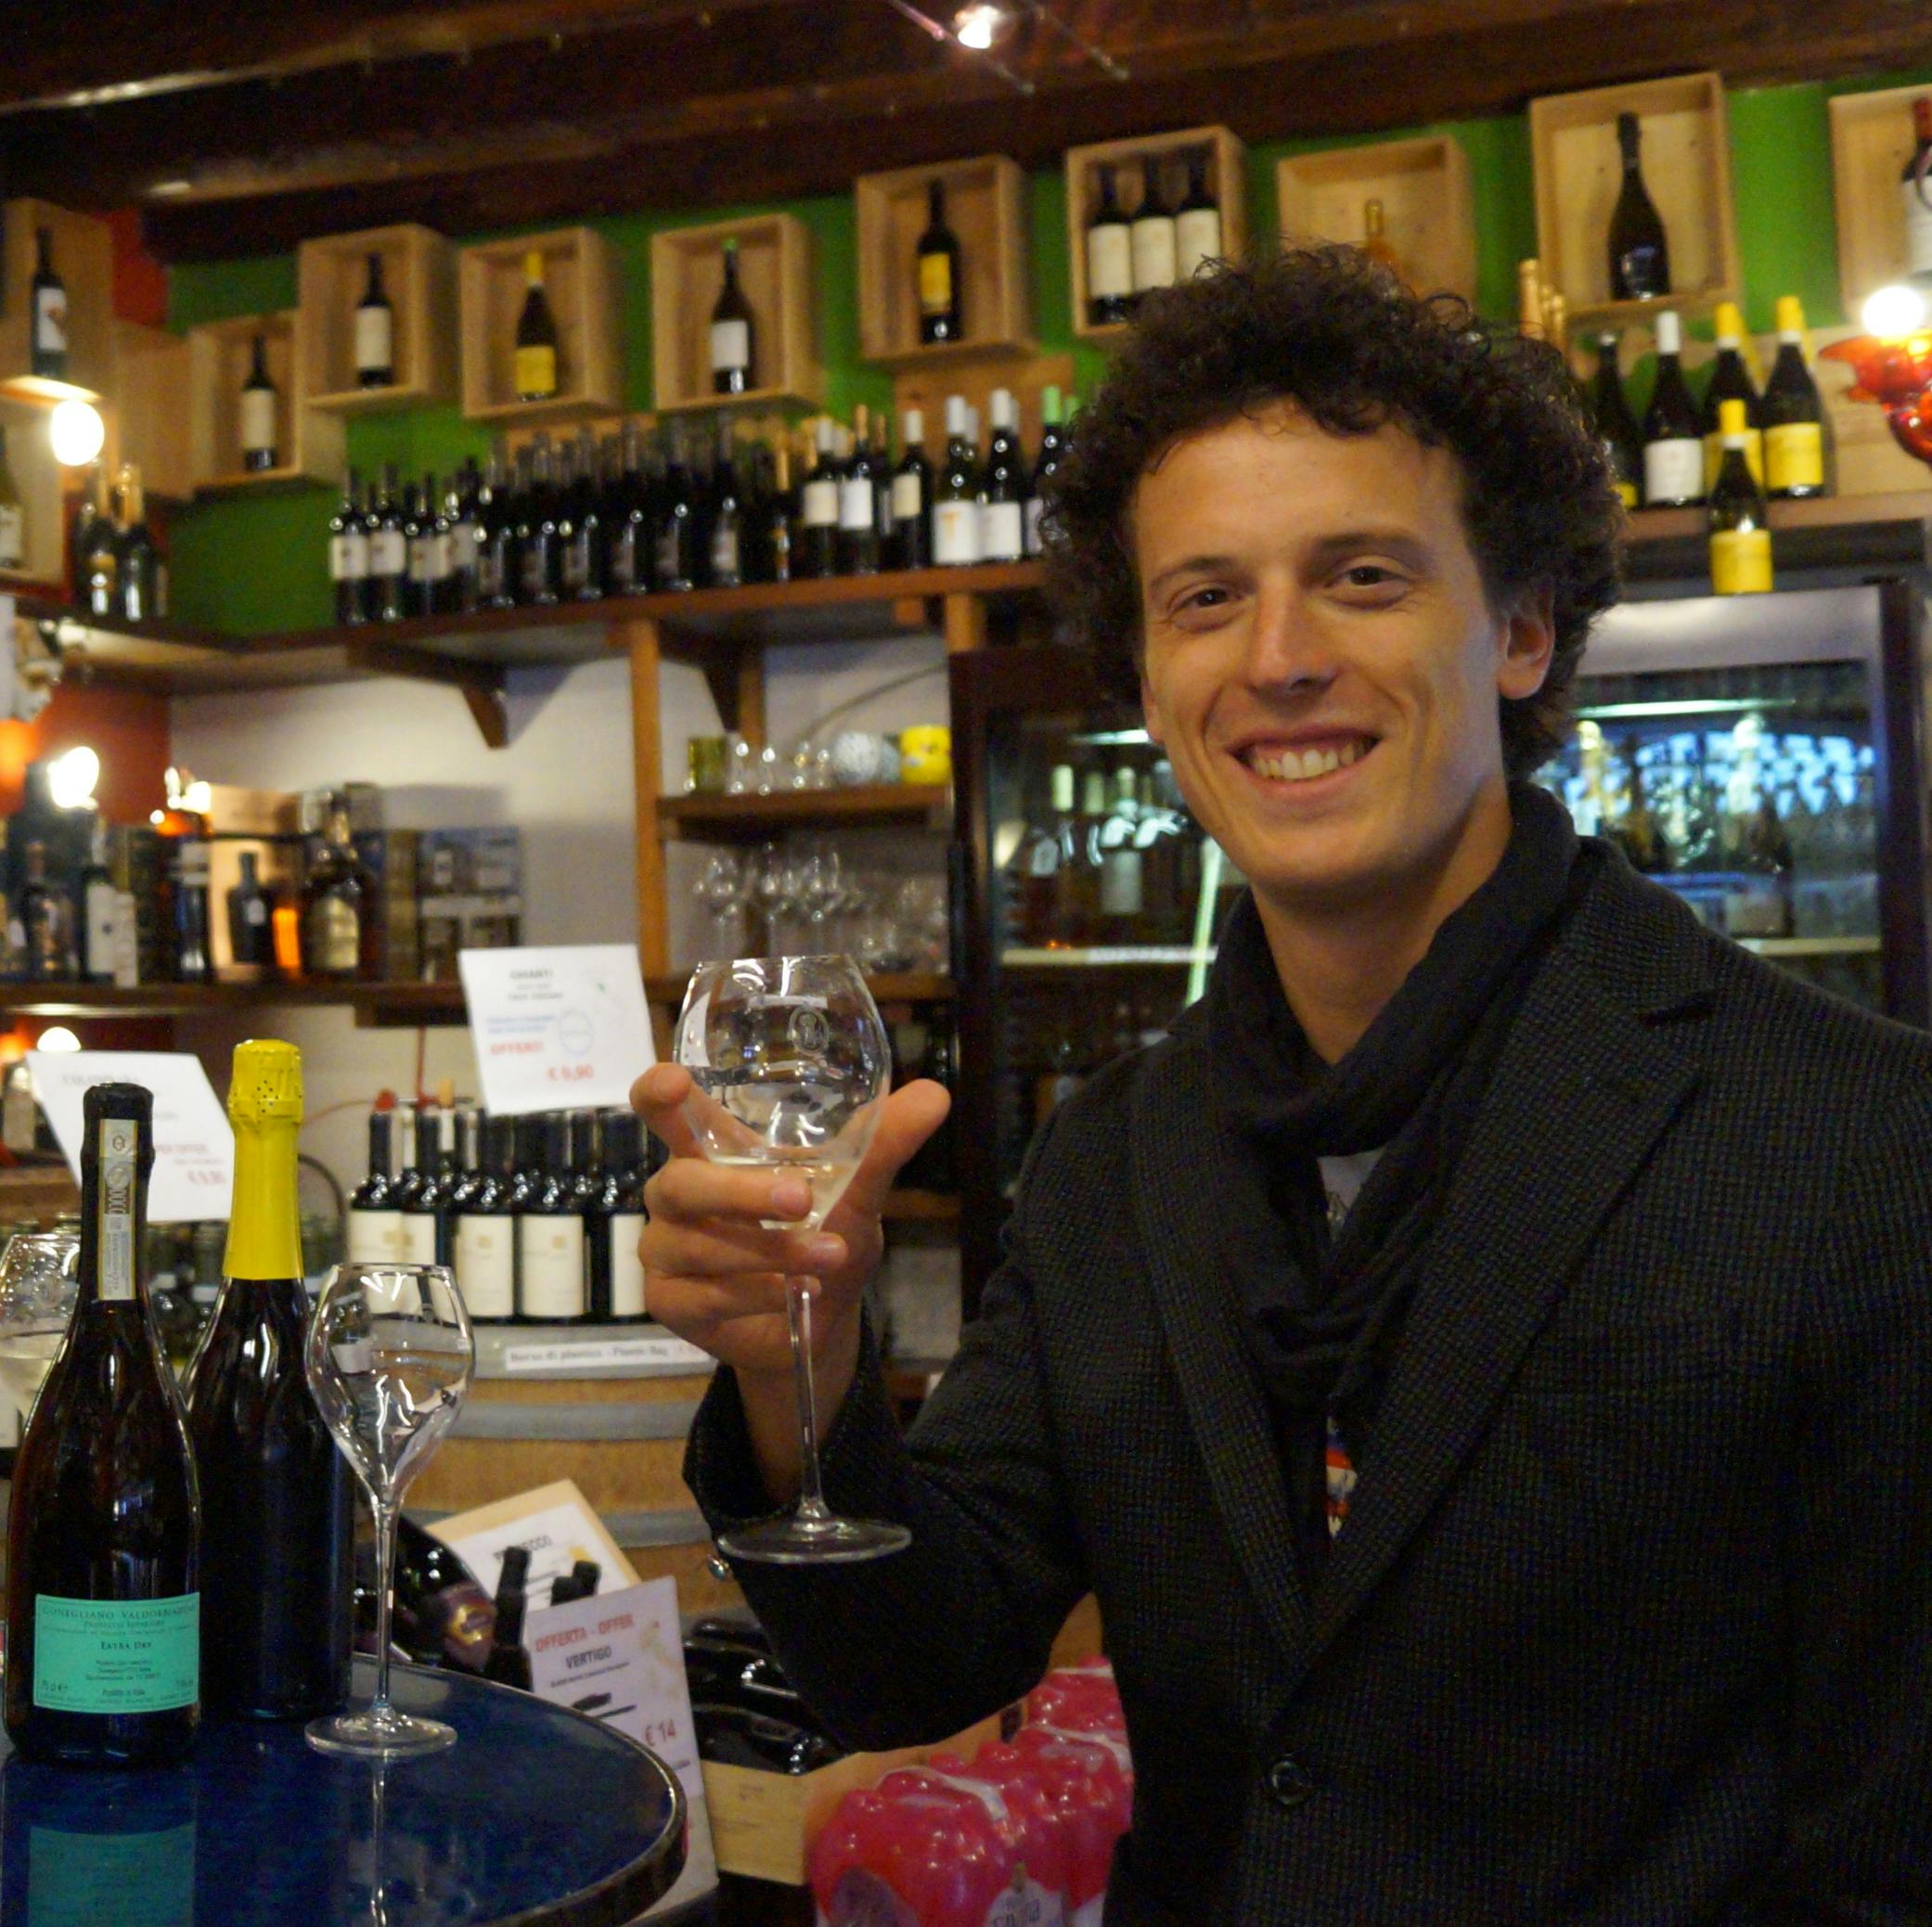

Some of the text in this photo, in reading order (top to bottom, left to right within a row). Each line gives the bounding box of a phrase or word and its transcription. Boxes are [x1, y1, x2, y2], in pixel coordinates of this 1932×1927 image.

[100, 1640, 131, 1650] EXTRA
[535, 1627, 587, 1652] OFFERTA
[565, 1645, 612, 1669] VERTIGO
[658, 1718, 676, 1743] 14
